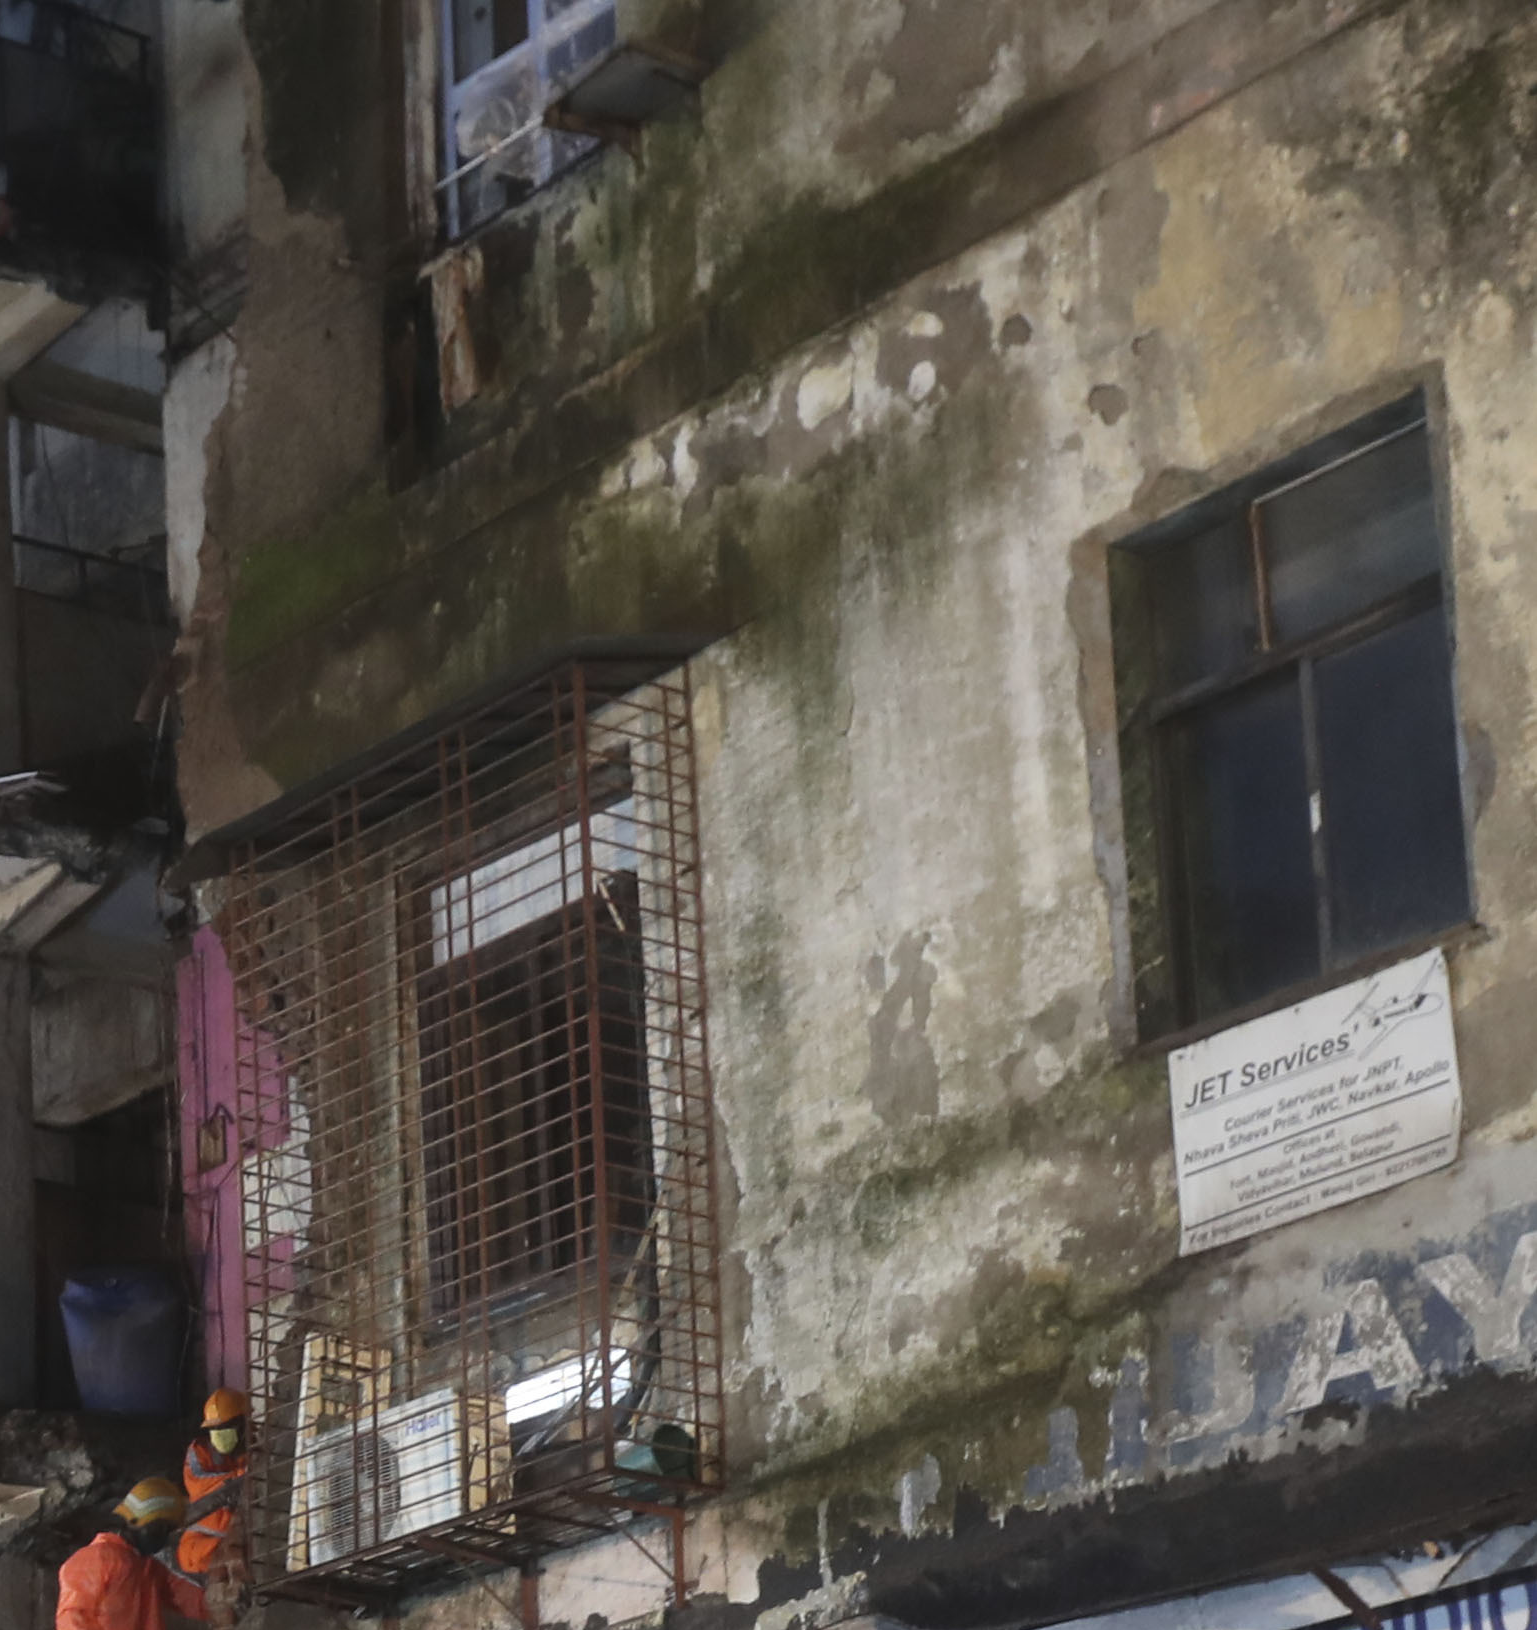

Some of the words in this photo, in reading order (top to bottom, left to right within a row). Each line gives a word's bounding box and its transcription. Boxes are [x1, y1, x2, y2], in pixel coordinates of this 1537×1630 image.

[1184, 1142, 1224, 1165] Nhava
[1406, 1059, 1451, 1085] Apollo
[1185, 1070, 1234, 1109] JET
[1224, 1107, 1273, 1132] Courier
[1277, 1083, 1334, 1112] Services
[1339, 1074, 1360, 1093] for
